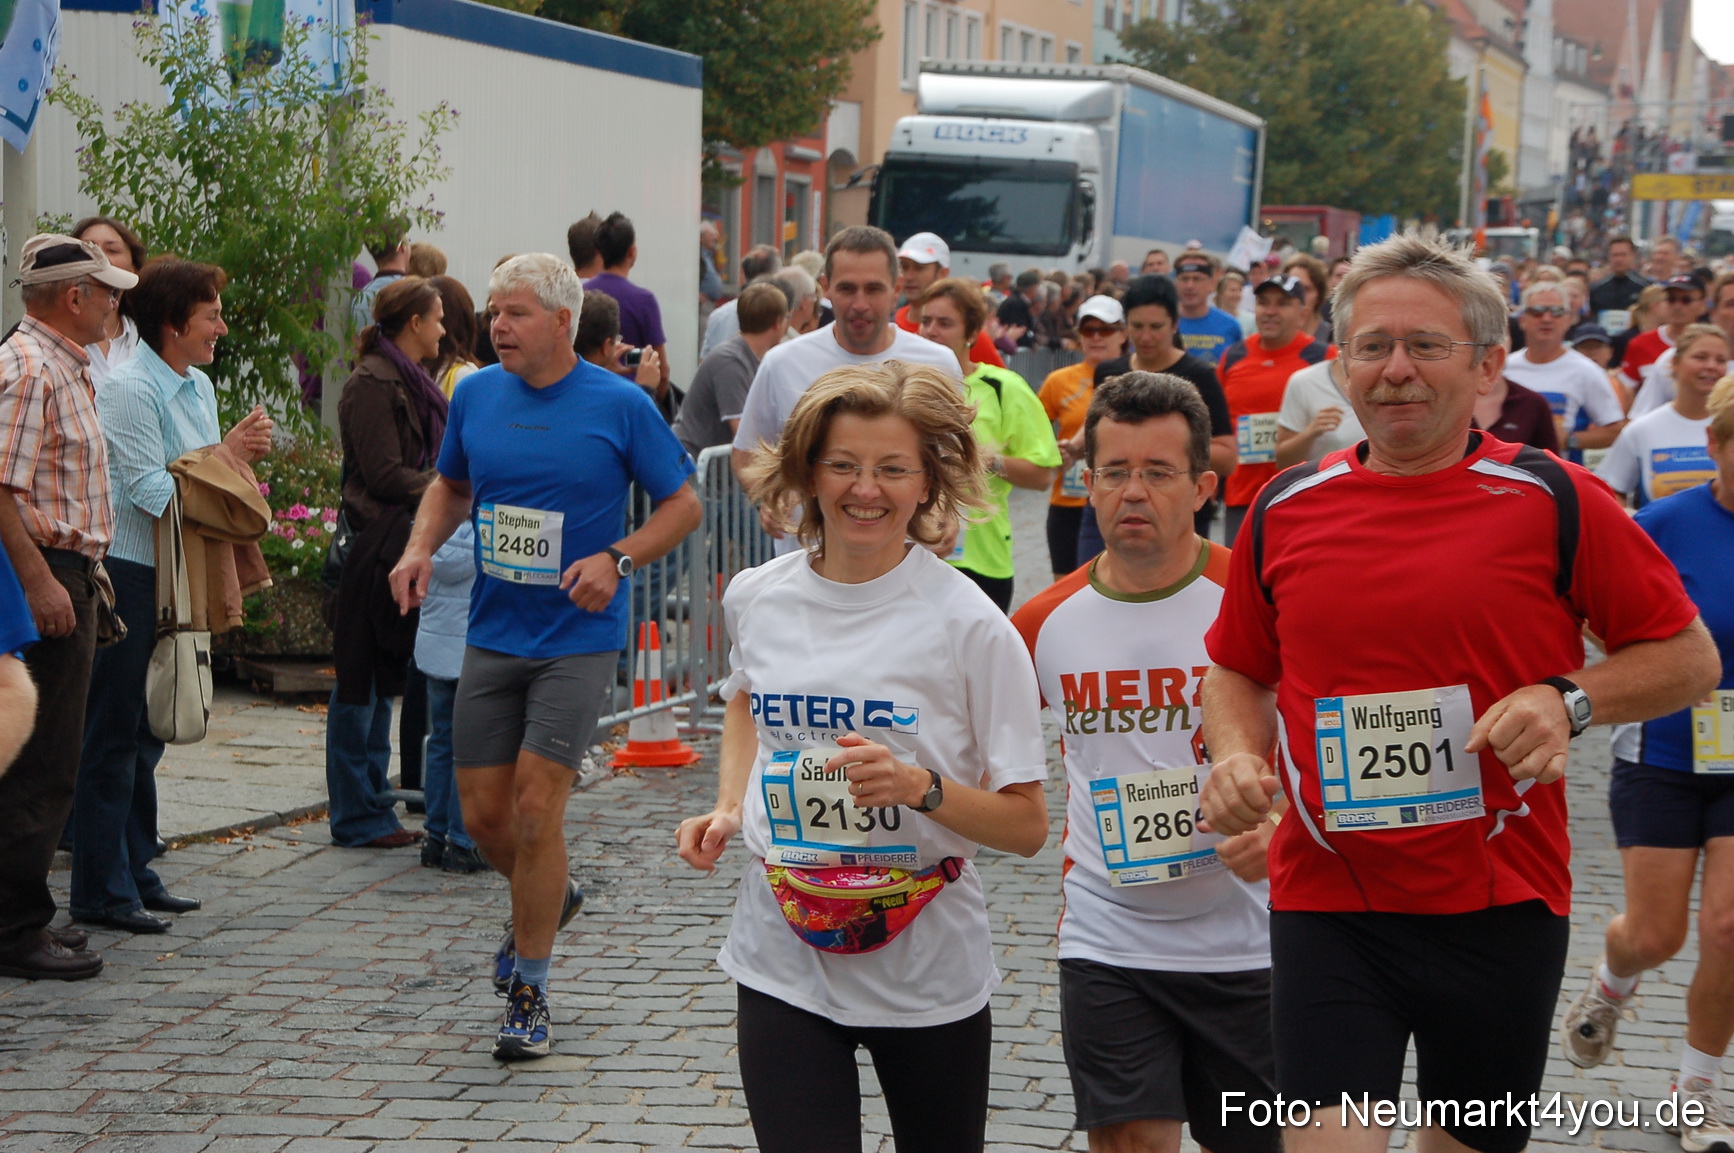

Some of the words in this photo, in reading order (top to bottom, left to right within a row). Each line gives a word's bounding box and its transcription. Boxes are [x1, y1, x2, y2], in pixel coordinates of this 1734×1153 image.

[934, 122, 1028, 143] BOCK
[1690, 179, 1734, 195] STA
[498, 511, 540, 530] Stephan
[498, 533, 549, 558] 2480
[1063, 697, 1192, 735] Reisen
[1352, 704, 1443, 733] Wolfgang
[1326, 746, 1334, 763] D
[1358, 738, 1454, 780] 2501
[1126, 774, 1199, 803] Reinhard
[769, 793, 780, 809] D
[1418, 797, 1480, 815] PFLEIDERER
[806, 797, 900, 833] 2130
[1337, 812, 1377, 824] BOCK
[1104, 817, 1113, 832] B
[781, 850, 818, 862] BOCK
[857, 853, 918, 863] PFLEIDERER
